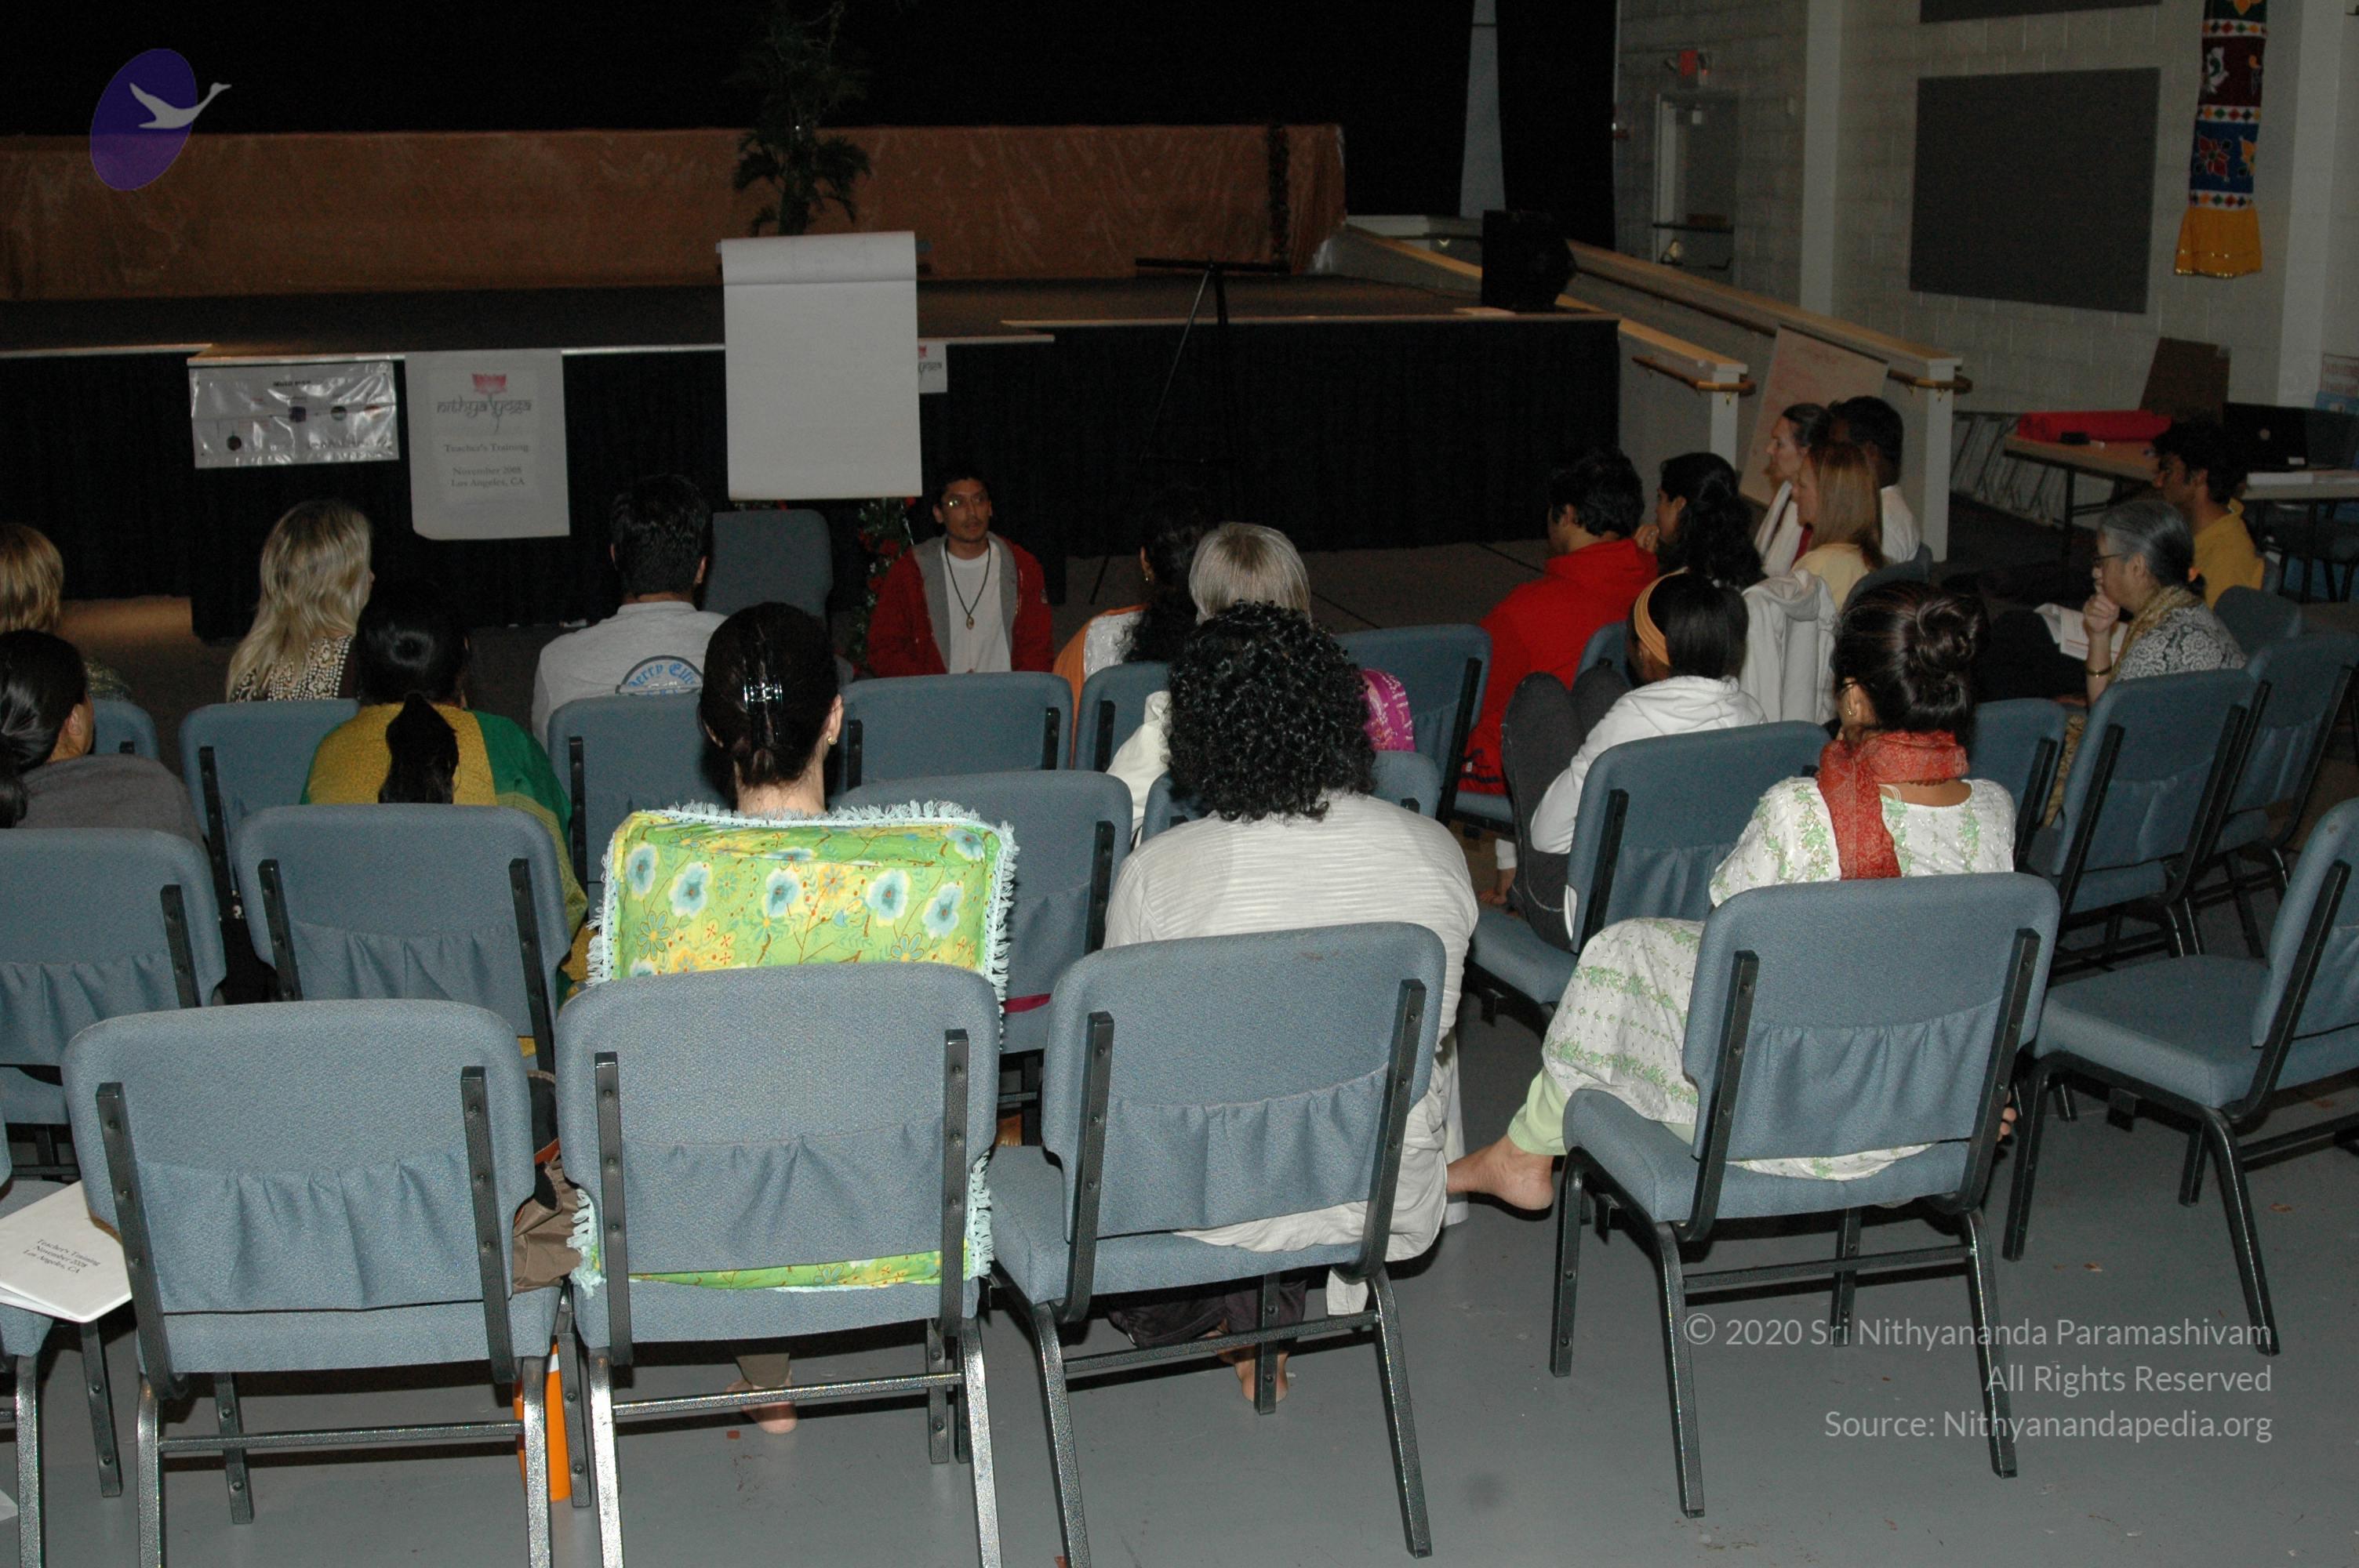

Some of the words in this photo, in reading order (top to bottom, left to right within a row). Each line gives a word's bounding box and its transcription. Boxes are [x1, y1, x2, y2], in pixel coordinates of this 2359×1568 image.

[443, 443, 488, 452] Teacher's
[490, 443, 529, 453] Training
[452, 466, 500, 476] November
[451, 478, 469, 487] Los
[510, 476, 526, 485] CA
[23, 1249, 37, 1258] Los
[34, 1245, 71, 1261] November
[38, 1239, 69, 1254] Teacher's
[71, 1251, 101, 1267] Training
